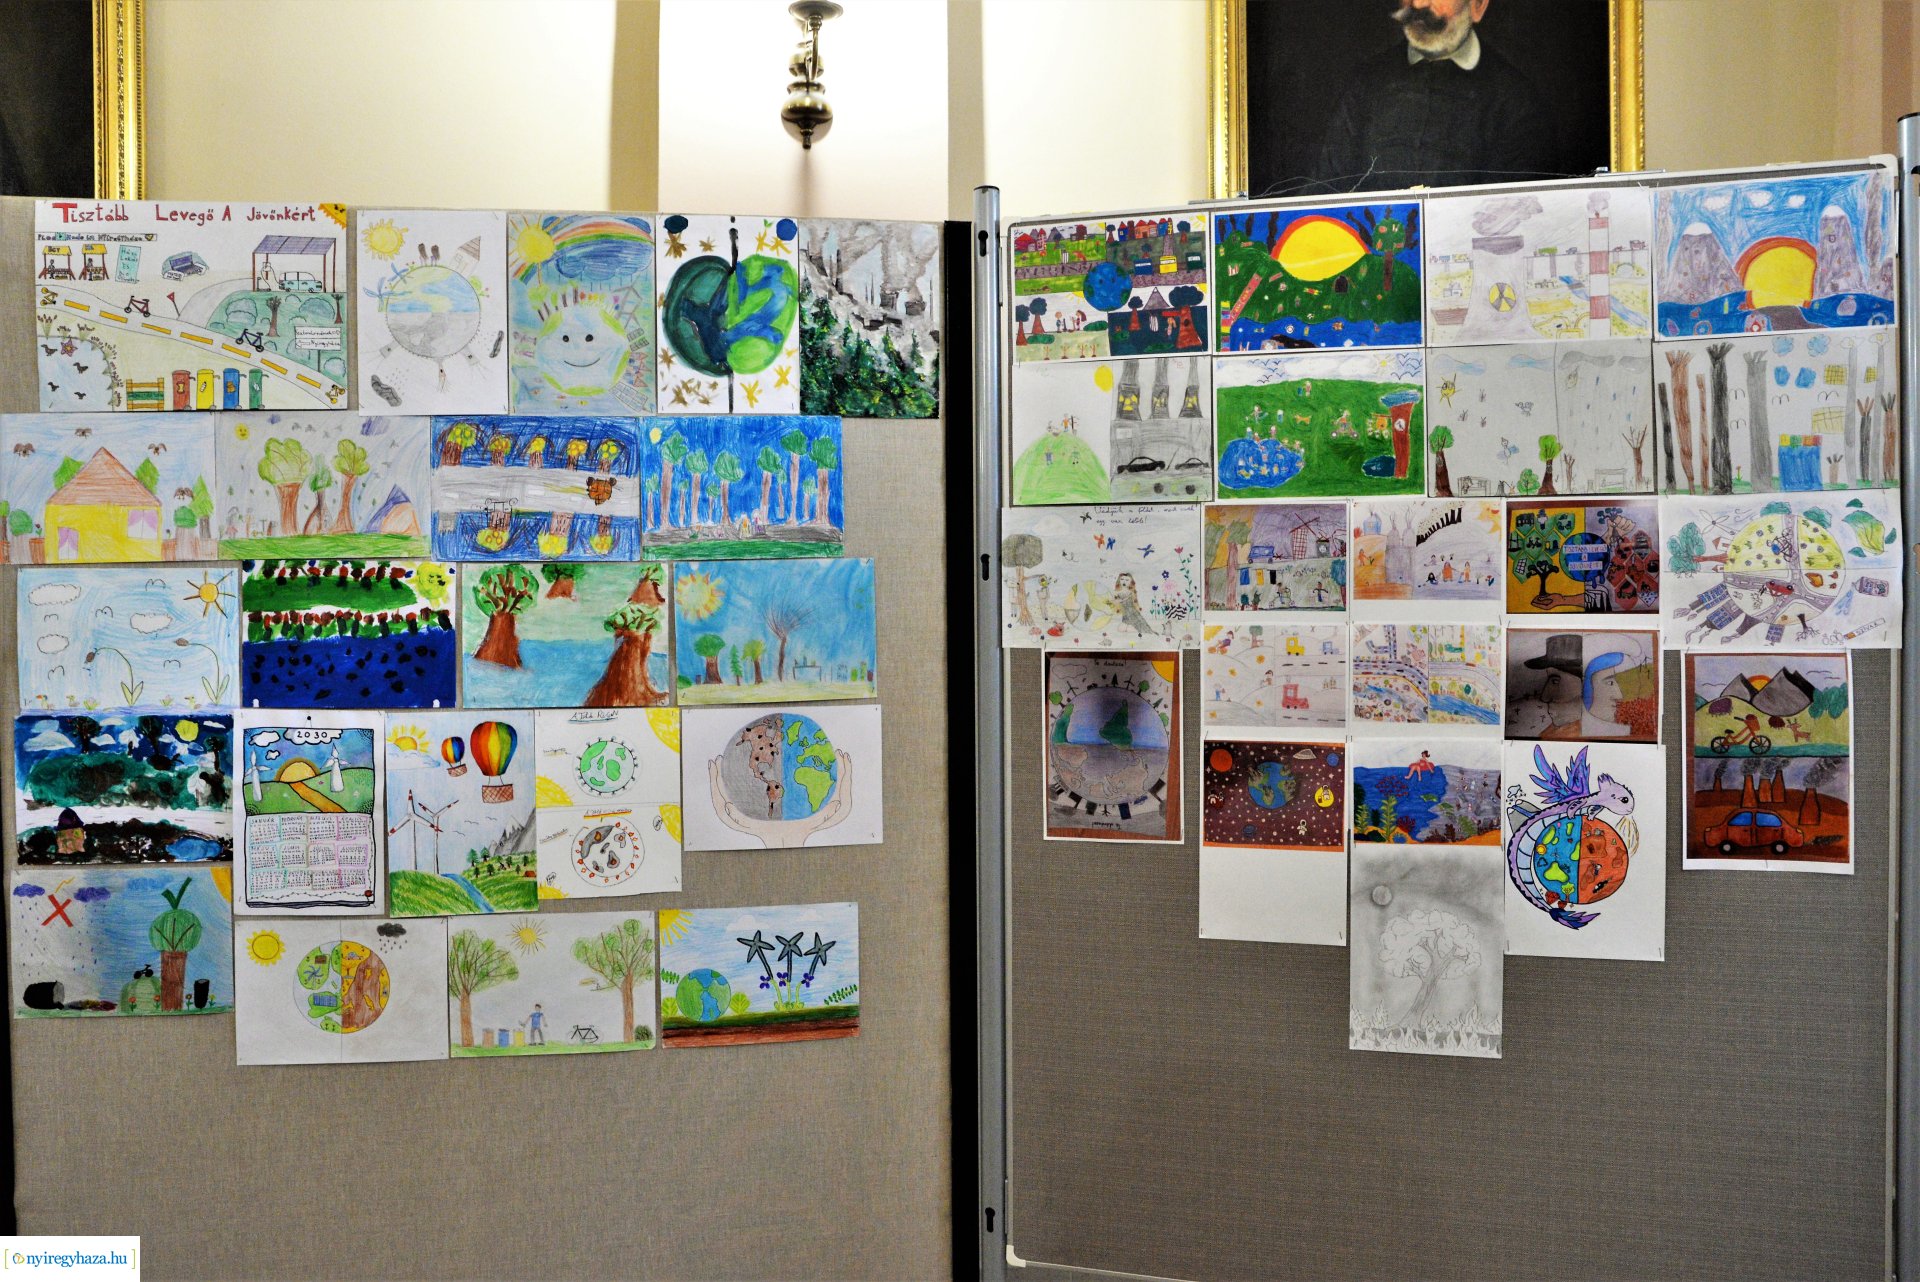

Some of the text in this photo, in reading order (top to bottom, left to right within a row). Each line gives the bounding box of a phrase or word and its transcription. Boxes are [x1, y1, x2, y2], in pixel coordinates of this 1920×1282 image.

[52, 202, 317, 226] Tisztább Levegő A Jövőnkért
[297, 731, 328, 739] 2030
